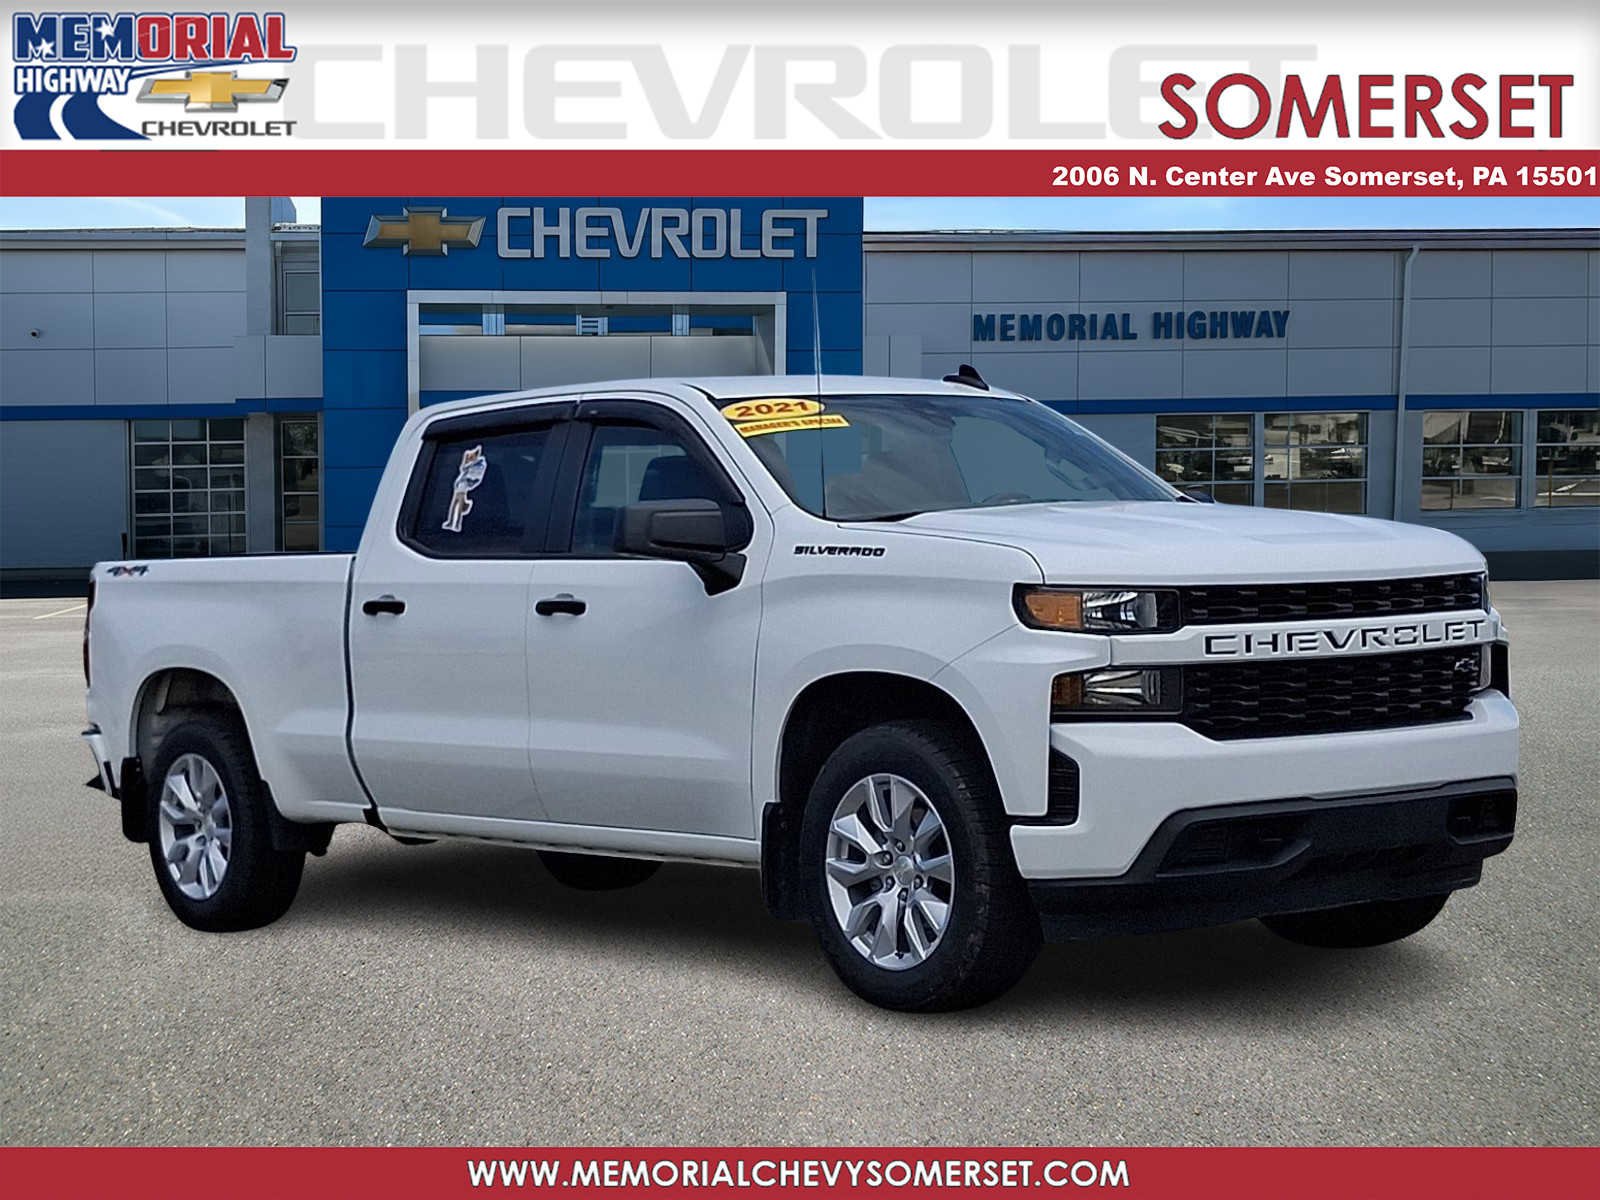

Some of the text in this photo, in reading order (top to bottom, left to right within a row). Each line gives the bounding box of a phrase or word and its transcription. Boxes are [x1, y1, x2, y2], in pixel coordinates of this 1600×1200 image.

[497, 207, 829, 259] CHEVROLET
[972, 310, 1290, 342] MEMORIAL HIGHWAY
[735, 401, 809, 418] 2021
[794, 545, 886, 557] SILVERADO
[1204, 620, 1486, 656] CHEVROLET
